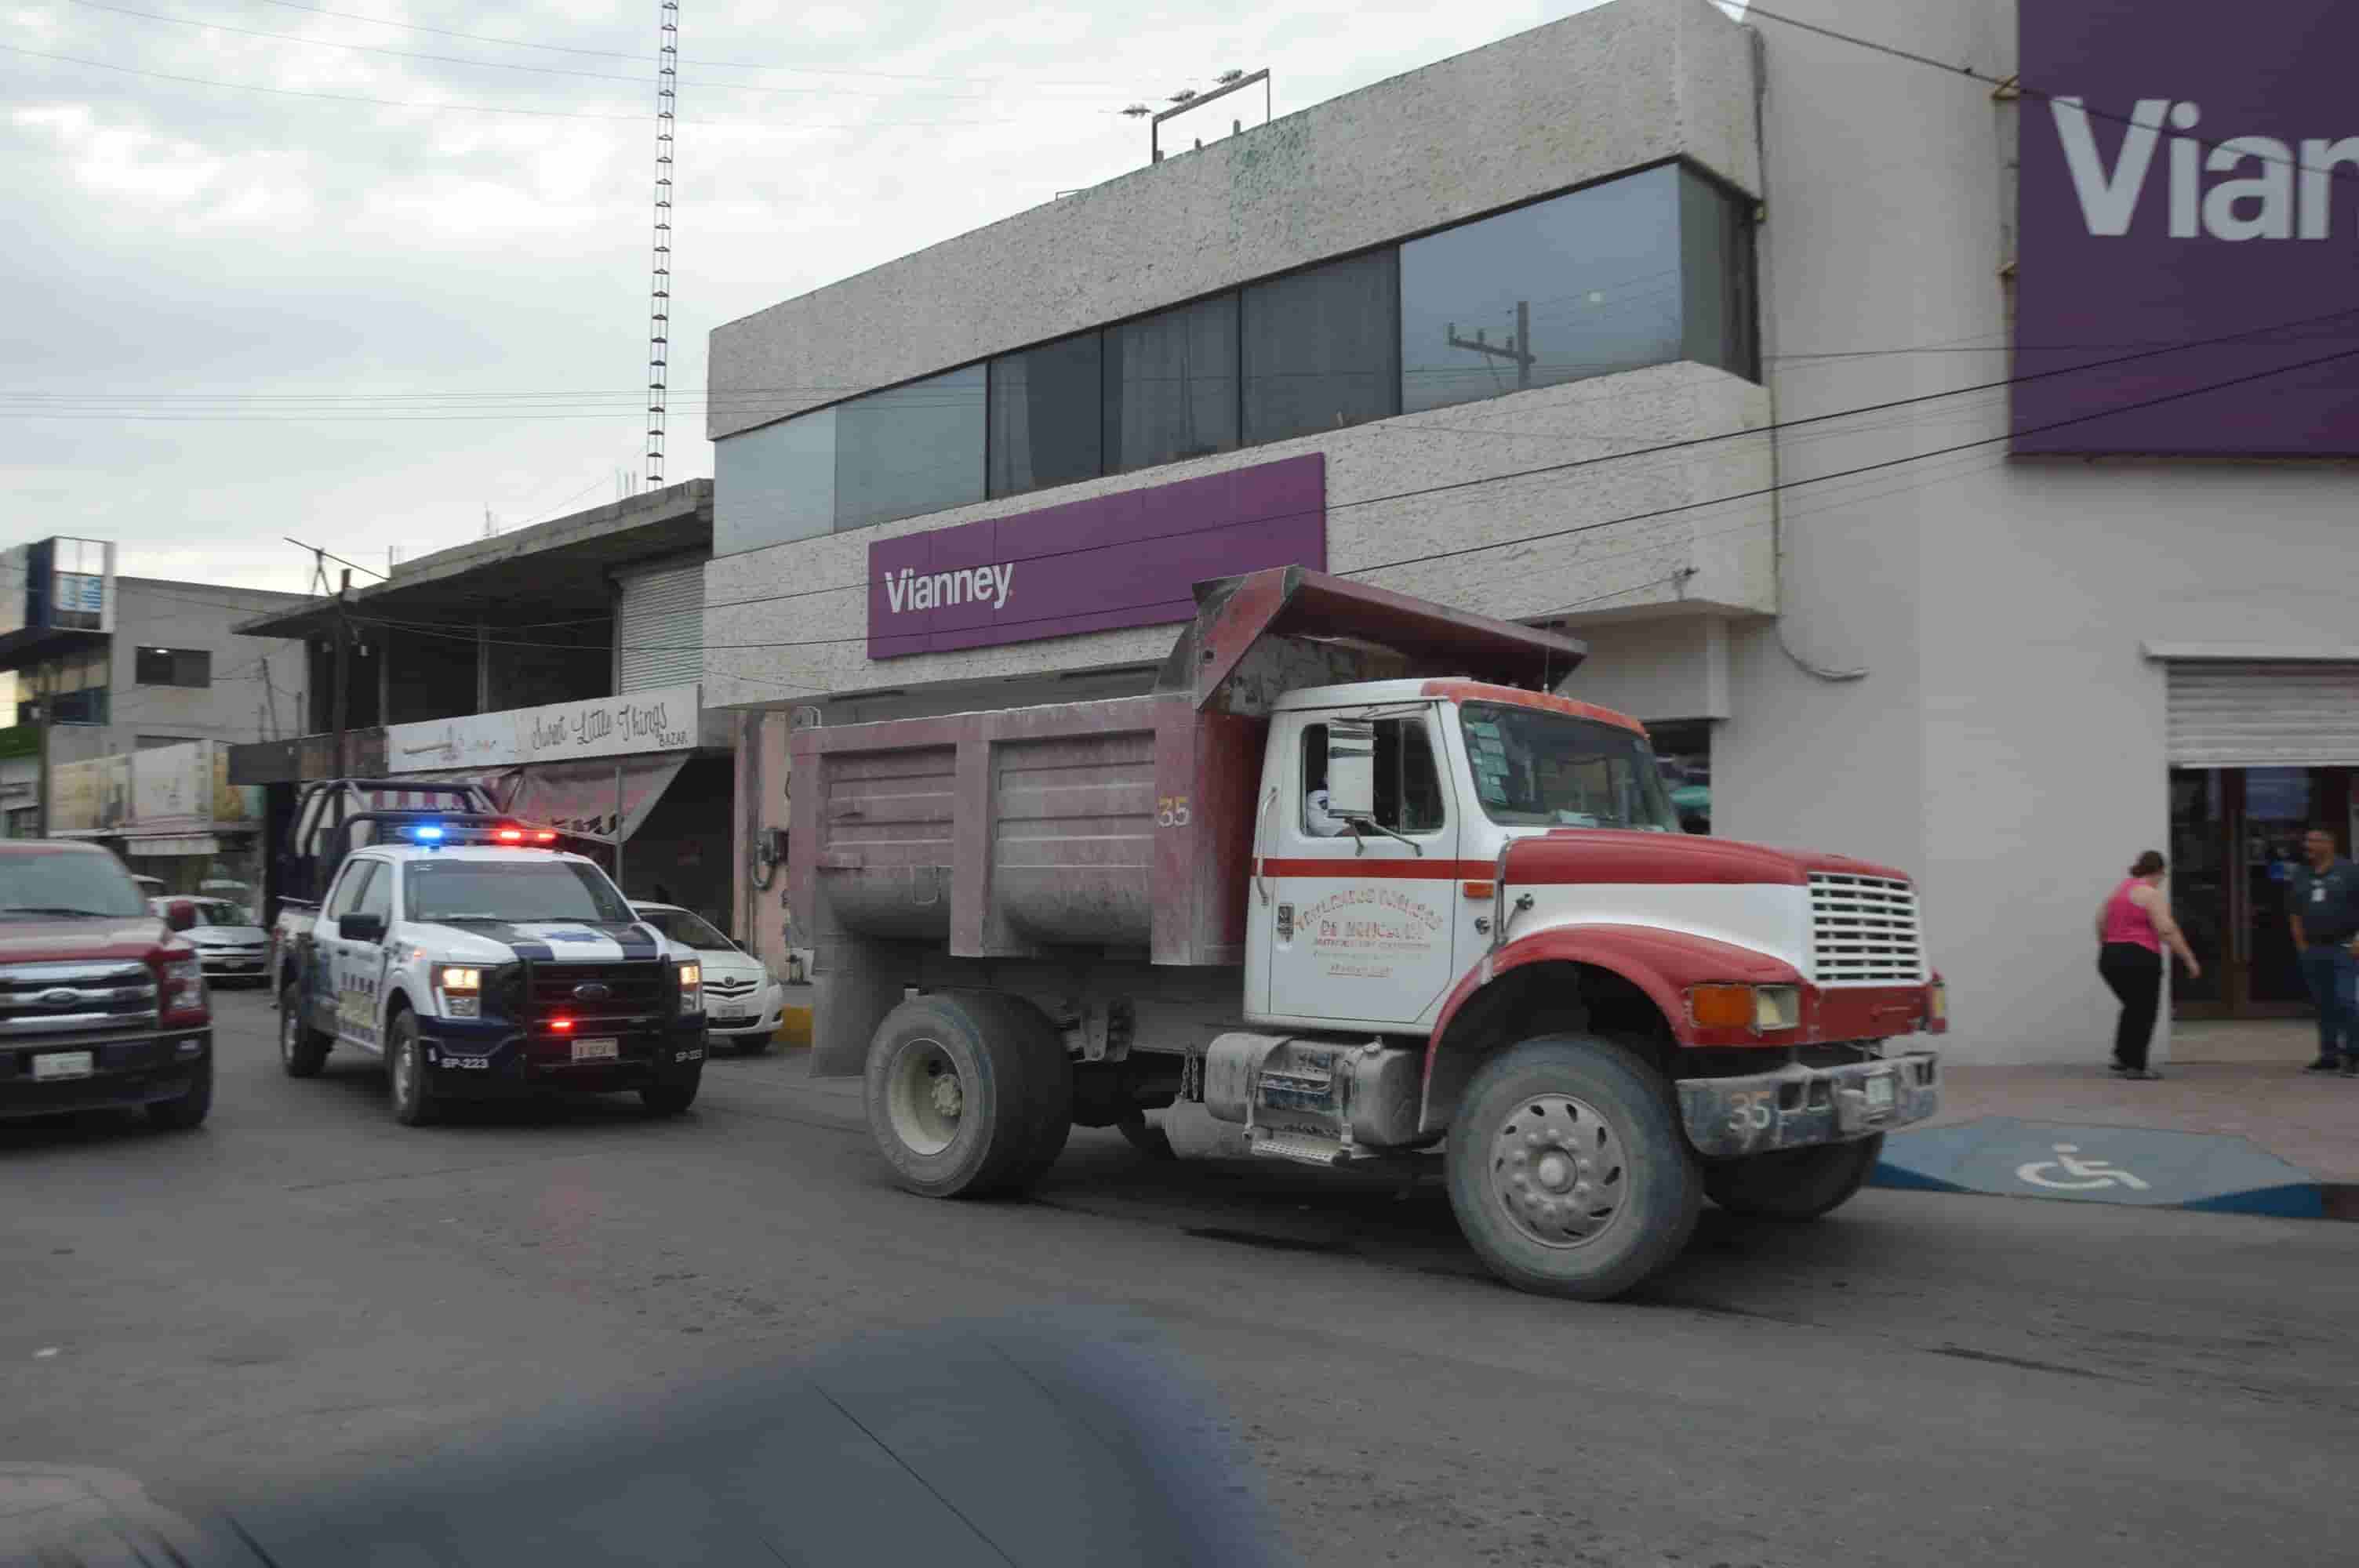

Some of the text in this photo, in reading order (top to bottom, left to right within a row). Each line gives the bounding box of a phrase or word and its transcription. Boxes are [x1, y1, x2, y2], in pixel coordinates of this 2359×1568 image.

[885, 563, 1014, 613] Vianney
[571, 709, 611, 745] Little
[616, 702, 667, 742] Things
[659, 731, 688, 746] BAZAR
[1158, 795, 1192, 828] 35
[441, 1058, 489, 1069] SP-223
[1728, 1091, 1772, 1131] 35
